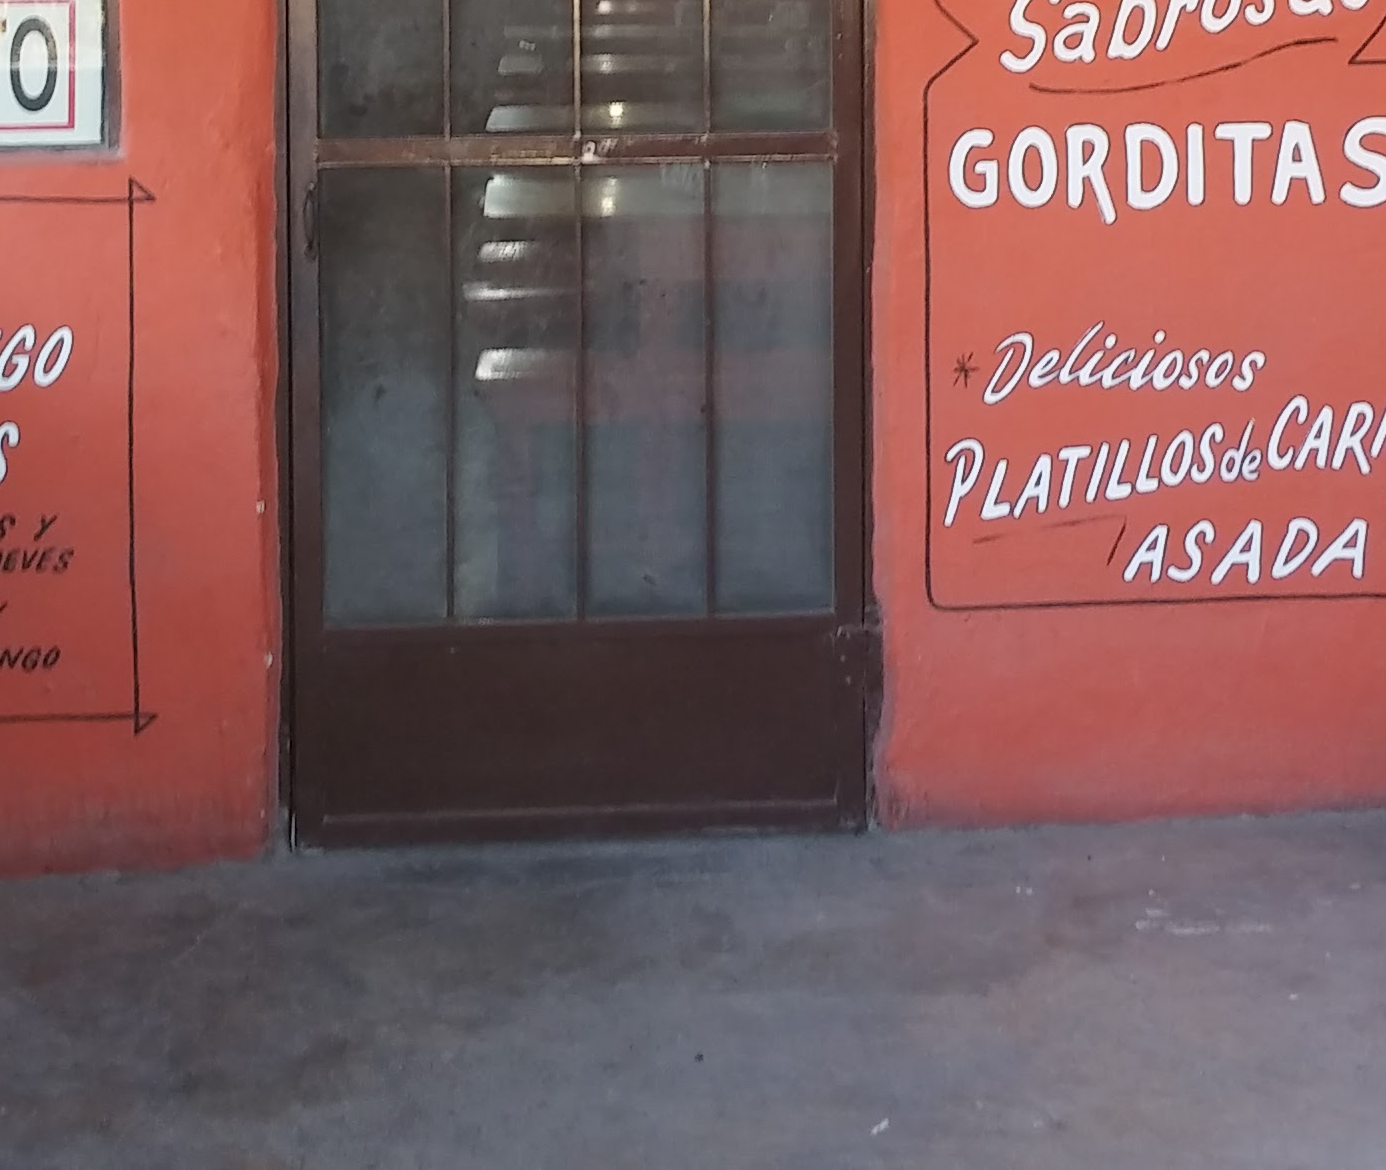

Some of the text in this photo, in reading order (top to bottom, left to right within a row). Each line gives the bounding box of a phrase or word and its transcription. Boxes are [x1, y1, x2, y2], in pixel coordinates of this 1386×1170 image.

[982, 320, 1266, 406] Deliciosos
[943, 422, 1225, 527] PLATILLOS
[1220, 418, 1262, 482] de
[32, 513, 58, 542] Y
[1122, 517, 1369, 586] ASADA
